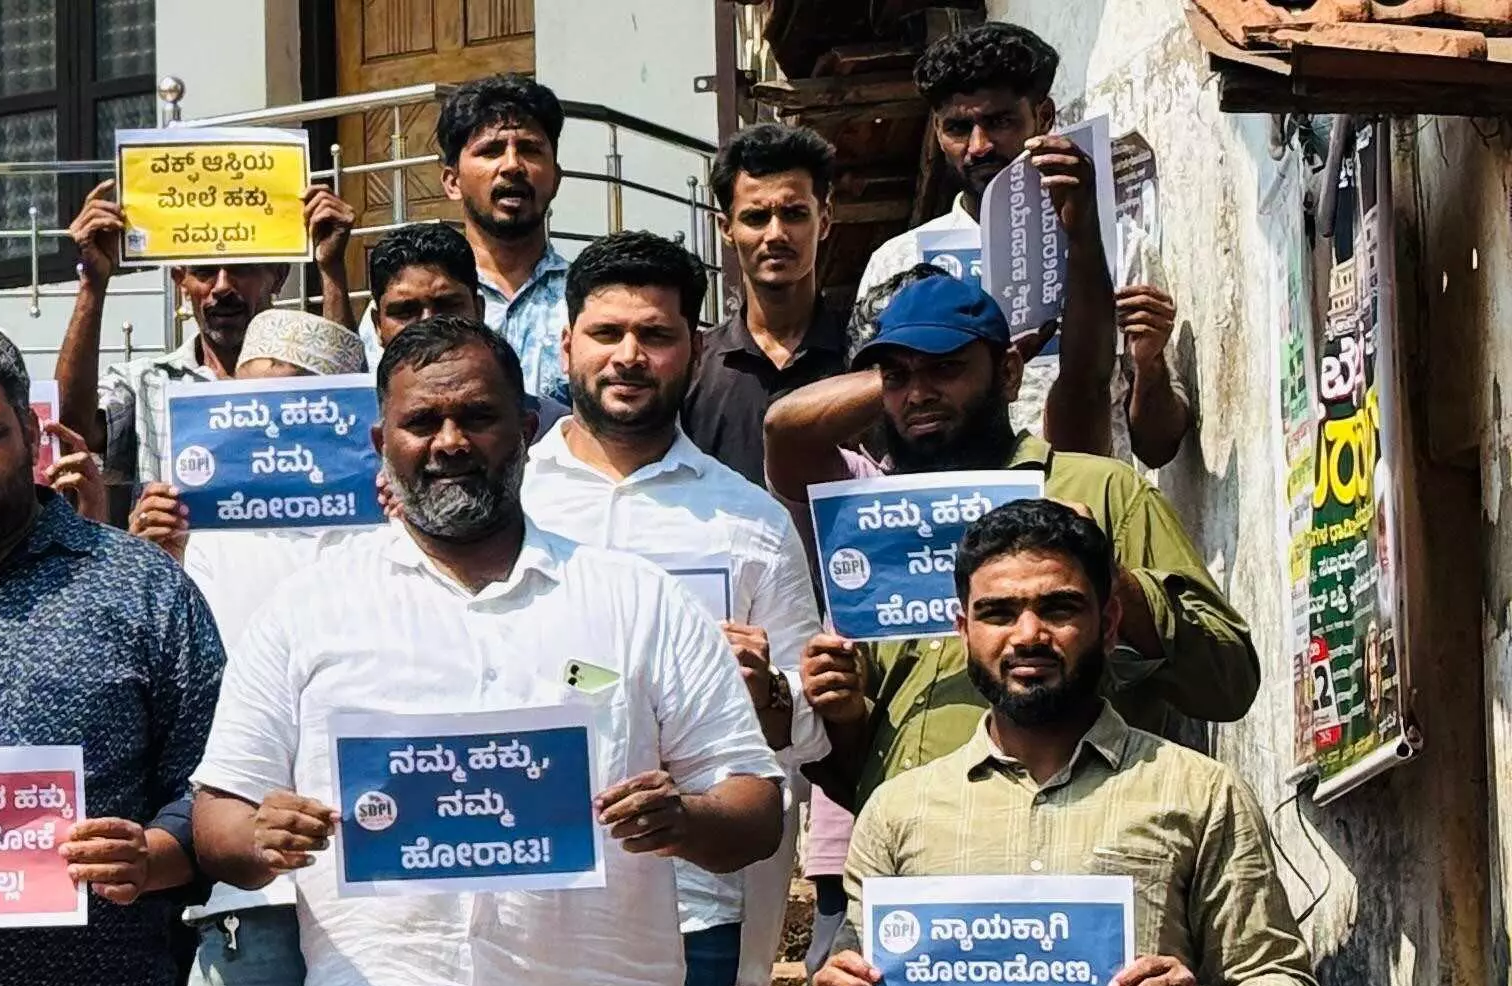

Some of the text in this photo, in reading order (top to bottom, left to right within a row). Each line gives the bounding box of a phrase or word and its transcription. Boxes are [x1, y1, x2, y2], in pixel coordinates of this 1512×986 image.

[150, 151, 275, 183] ವಕ್ಫ್ ಆಸ್ತಿಯ
[158, 185, 274, 216] ಮೇಲೆ ಹಕ್ಕು
[172, 222, 256, 251] ನಮ್ಮದು!
[208, 395, 356, 438] ನಮ್ಮ ಹಕ್ಕು,
[251, 443, 324, 484] ನಮ್ಮ
[217, 491, 356, 520] ಹೋರಾಟ!
[857, 497, 933, 538] ನಮ್ಮ
[832, 557, 866, 577] SDPI
[389, 739, 550, 783] ನಮ್ಮ ಹಕ್ಕು,
[14, 783, 74, 819] ಹಕ್ಕು
[358, 801, 392, 818] SDPI
[436, 788, 516, 827] ನಮ್ಮ
[401, 836, 551, 870] ಹೋರಾಟ!
[883, 920, 915, 939] SDPI
[931, 912, 1069, 951] ನ್ಯಾಯಕ್ಕಾಗಿ
[904, 953, 1099, 985] ಹೋರಾಡೋಣ,
